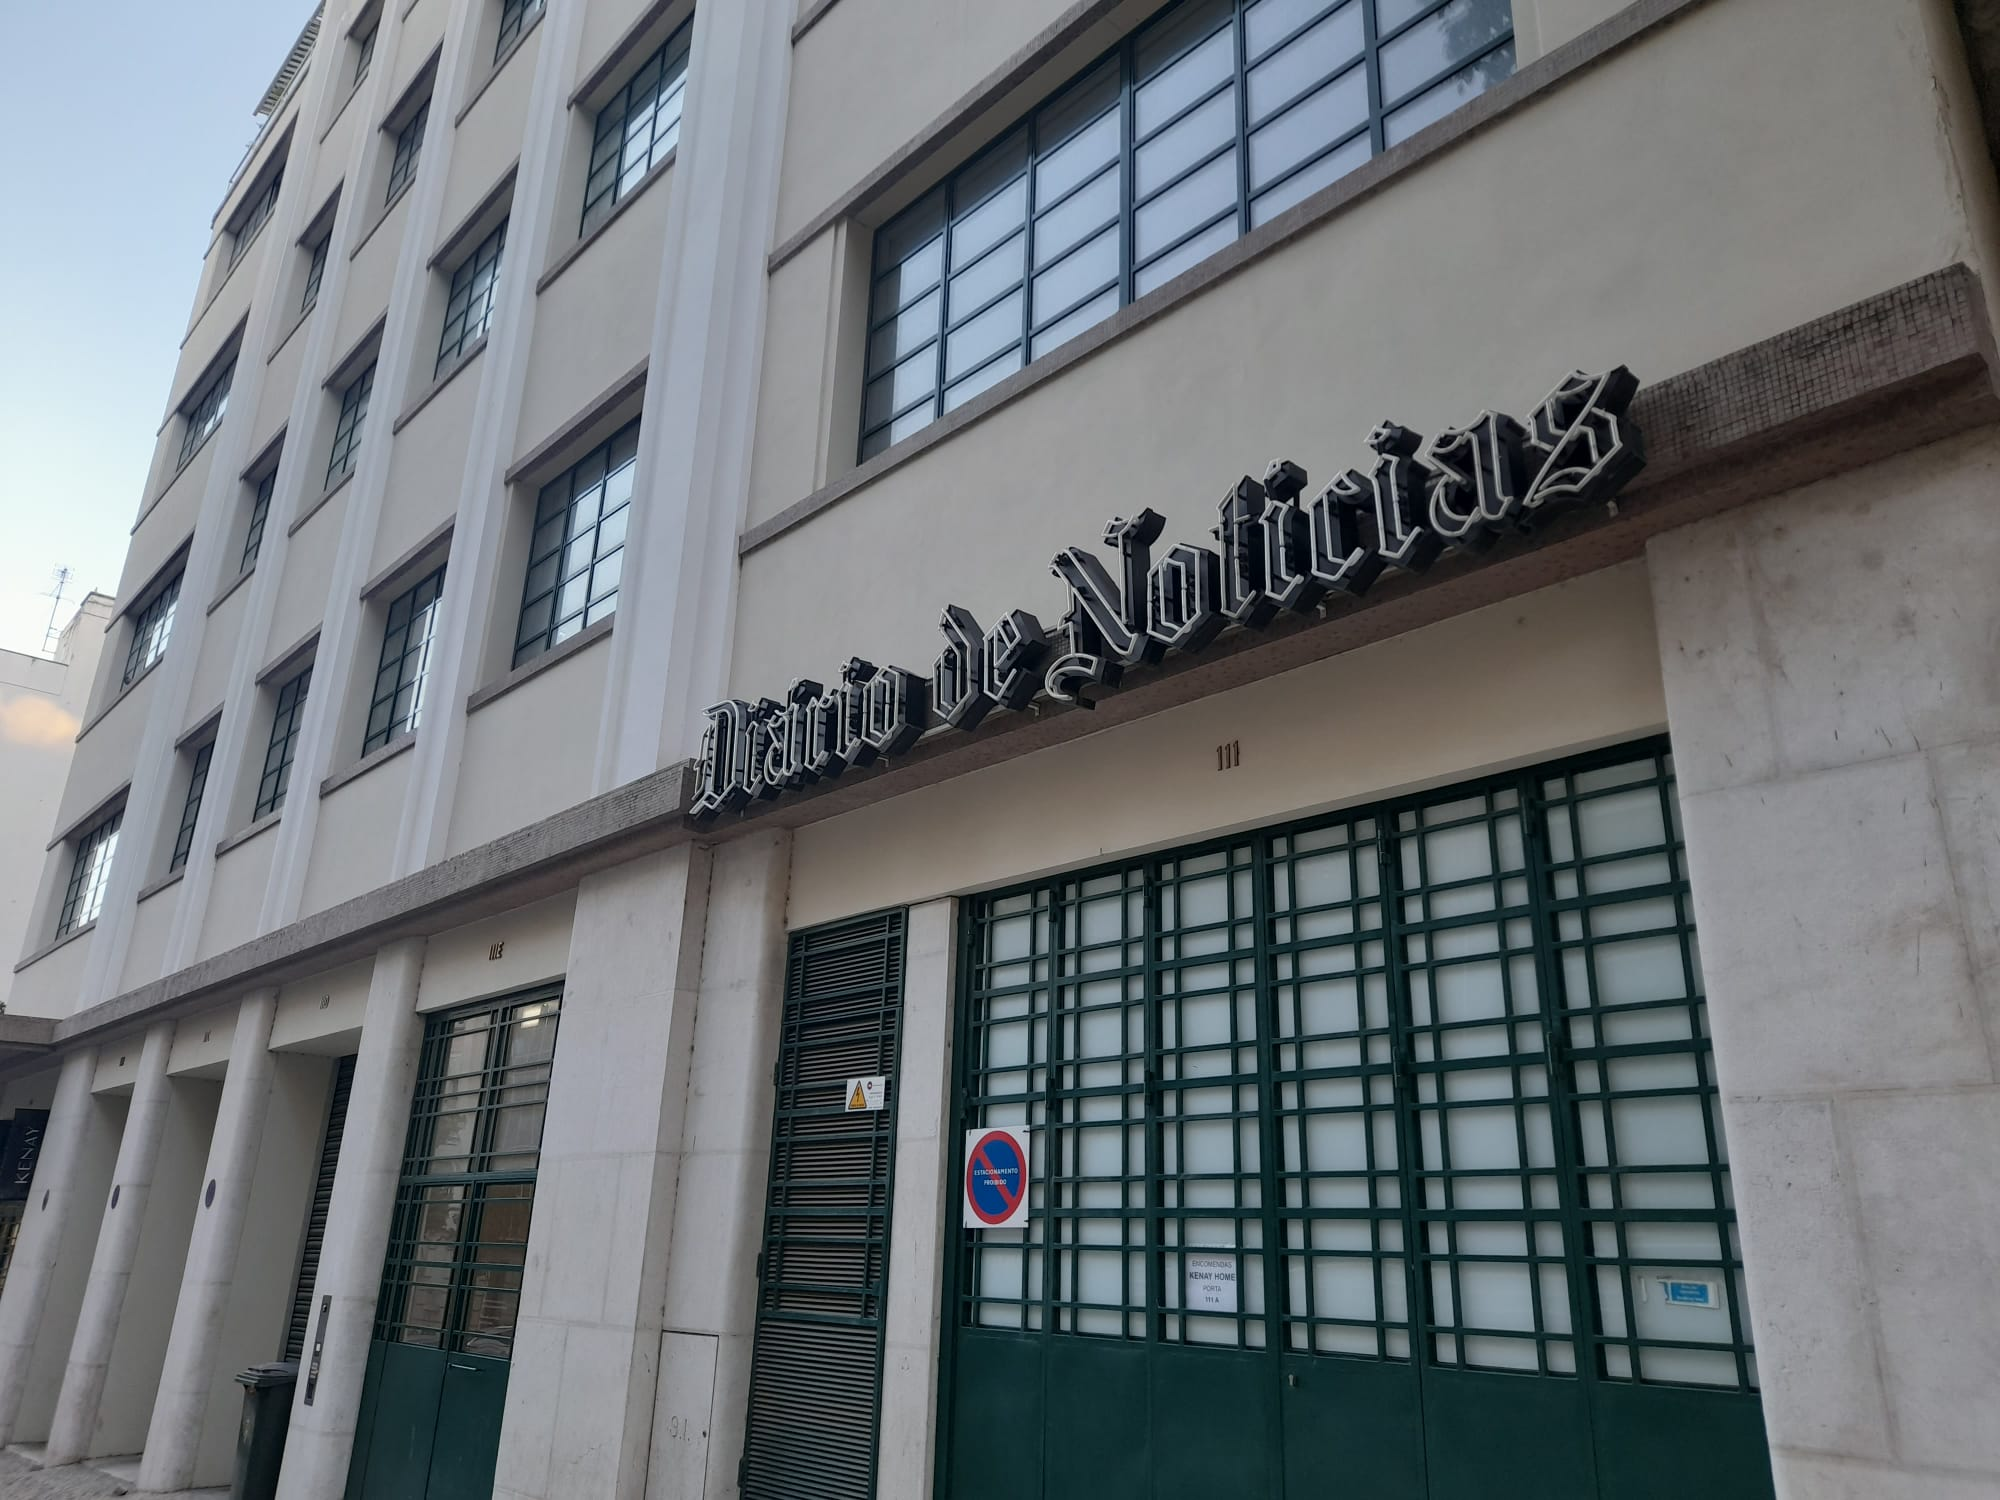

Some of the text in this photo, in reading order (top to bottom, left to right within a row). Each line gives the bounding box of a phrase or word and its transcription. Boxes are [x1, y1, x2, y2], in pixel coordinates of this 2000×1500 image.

[932, 603, 1048, 732] de
[1216, 739, 1240, 772] 111
[14, 1127, 40, 1184] KENAY
[974, 1167, 1019, 1176] ESTACIONAMENTO
[1191, 1260, 1232, 1268] ENCOMENDAS
[1189, 1271, 1237, 1282] KENAY HOME
